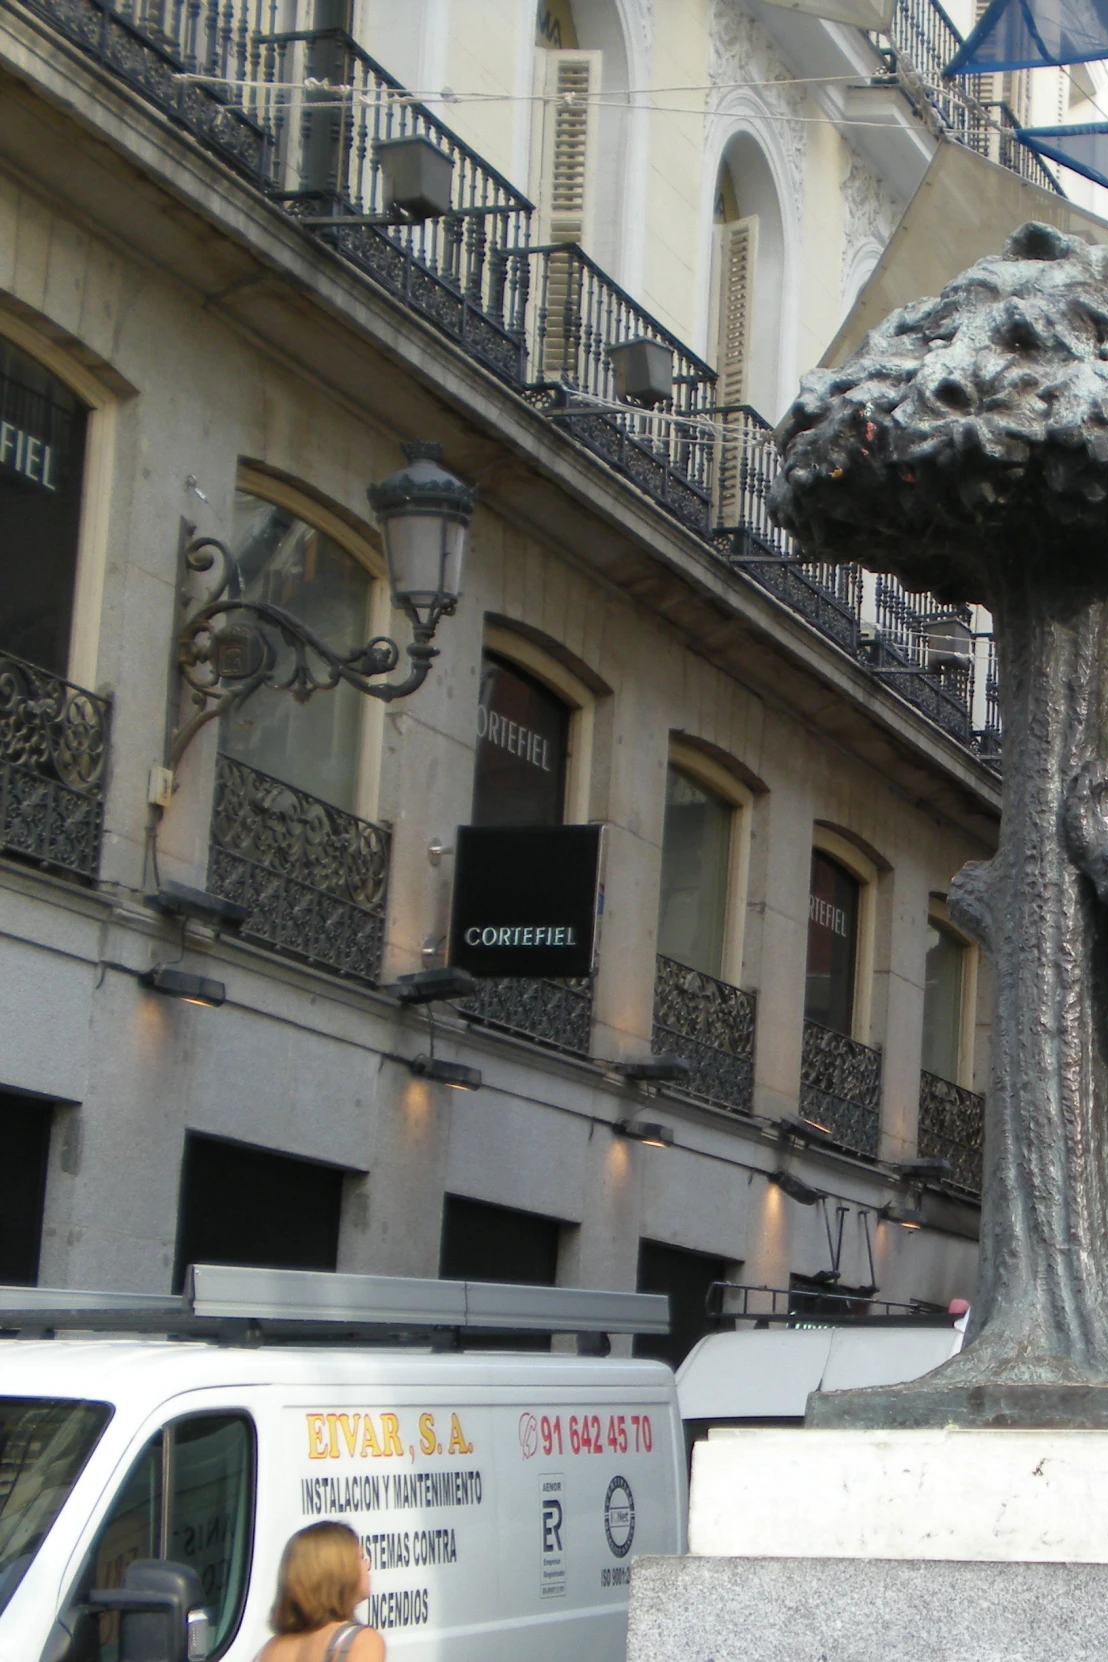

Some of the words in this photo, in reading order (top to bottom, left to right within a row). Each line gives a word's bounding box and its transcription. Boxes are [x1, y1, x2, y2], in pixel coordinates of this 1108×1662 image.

[0, 421, 56, 490] FIEL
[465, 926, 577, 946] CORTEFIEL
[540, 1415, 563, 1456] 91
[568, 1415, 603, 1455] 642
[607, 1414, 628, 1454] 45
[630, 1415, 653, 1453] 70
[301, 1474, 380, 1516] INSTALACION
[382, 1474, 390, 1510] Y
[393, 1470, 483, 1510] MANTENIMIENTO
[413, 1528, 458, 1567] CONTRA
[601, 1567, 611, 1588] ISO
[367, 1587, 429, 1631] INCENDIOS
